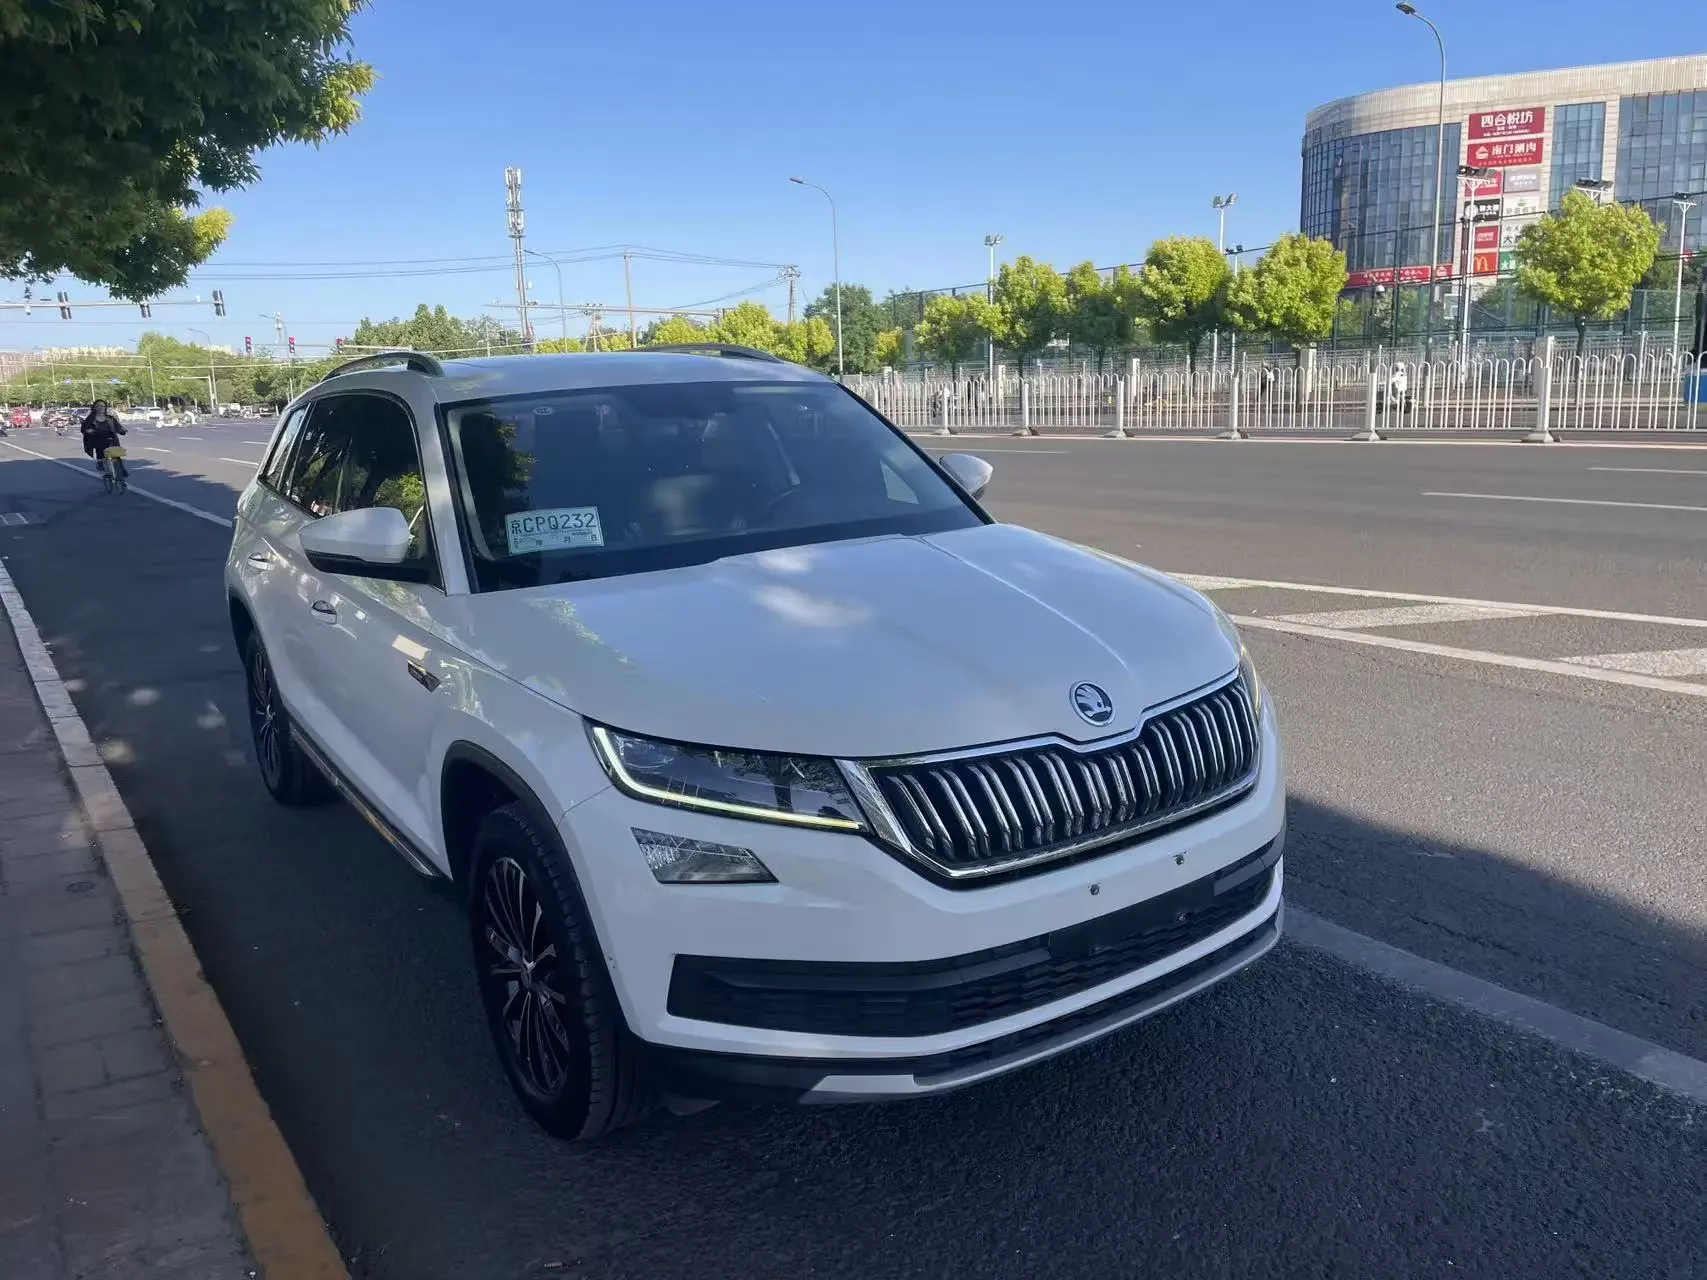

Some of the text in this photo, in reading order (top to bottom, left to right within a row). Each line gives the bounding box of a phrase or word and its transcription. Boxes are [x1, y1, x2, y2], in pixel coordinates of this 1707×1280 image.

[1492, 141, 1537, 156] 南门涮肉
[511, 513, 596, 534] 京CPQ232
